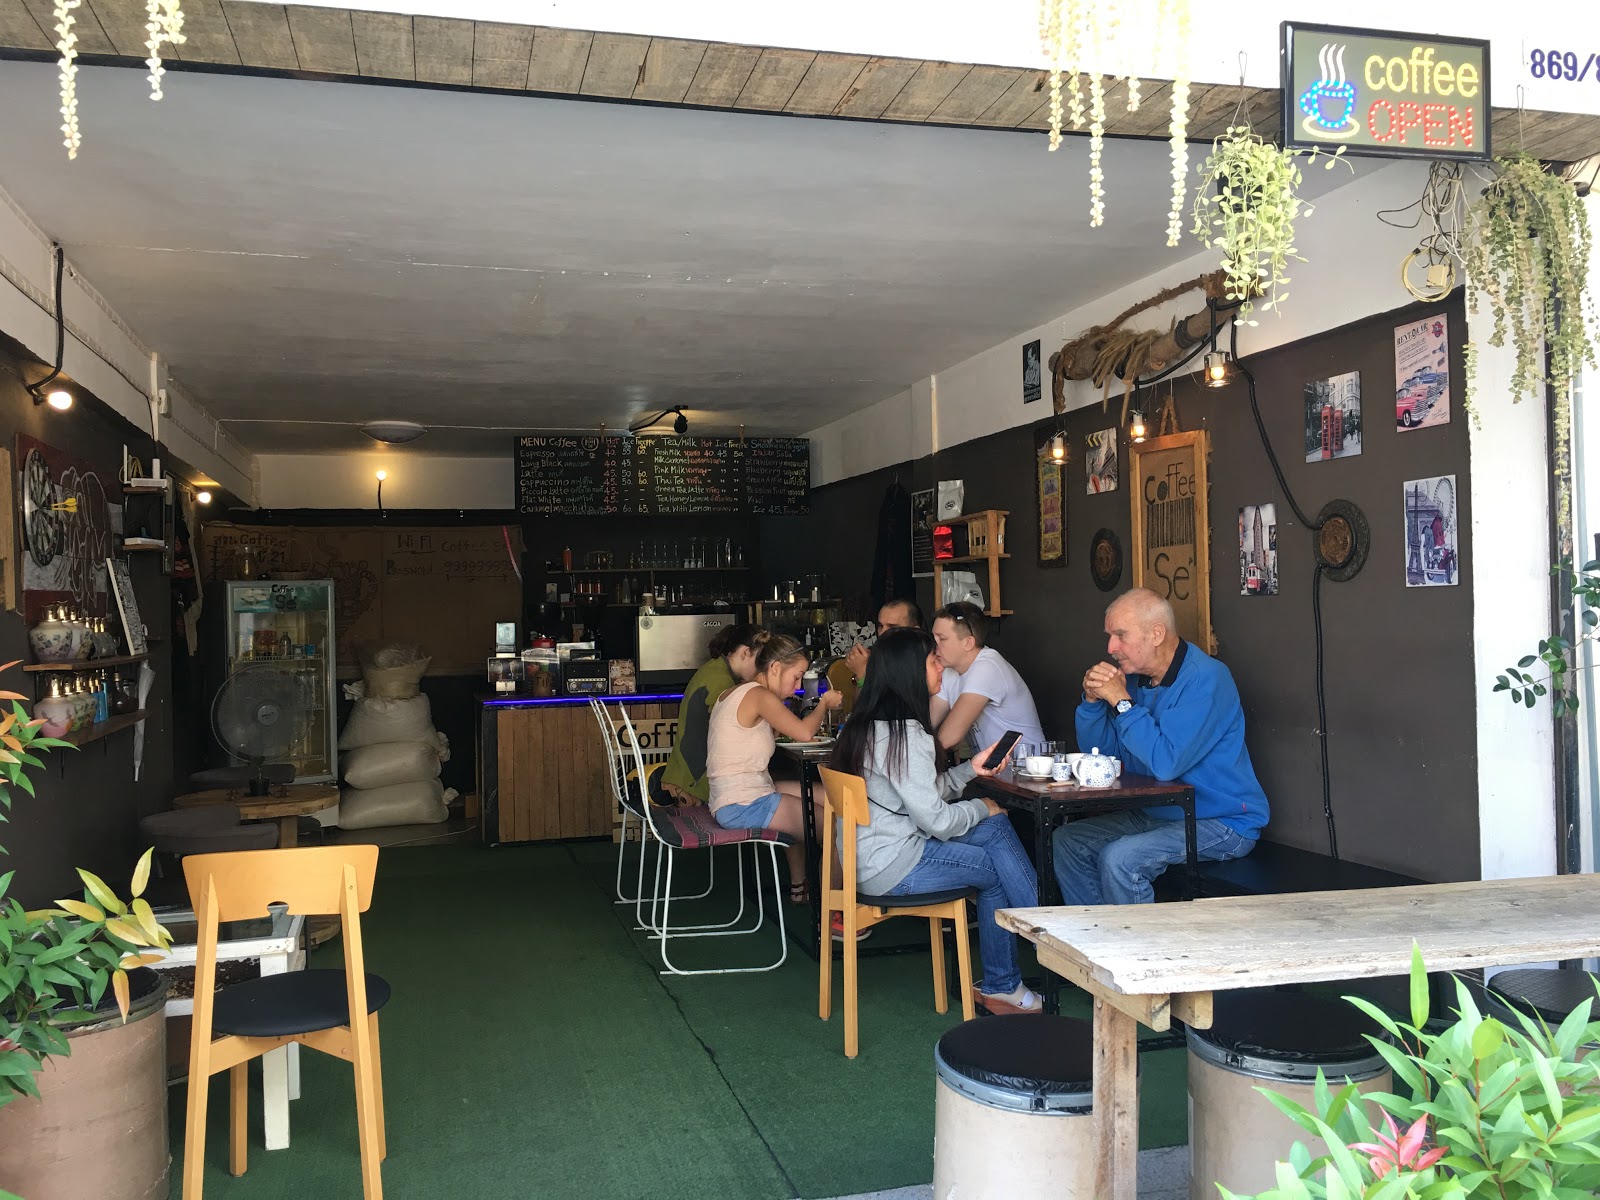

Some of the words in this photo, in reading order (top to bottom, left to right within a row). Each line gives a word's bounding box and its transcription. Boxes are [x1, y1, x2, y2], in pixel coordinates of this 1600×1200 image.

[1364, 46, 1479, 98] coffee
[1368, 99, 1475, 148] OPEN
[520, 437, 546, 447] MENU
[548, 437, 578, 448] Coffee
[660, 437, 698, 448] Tea/Milk
[520, 449, 556, 459] Espresso
[669, 448, 682, 457] Milk
[520, 460, 540, 471] Long
[541, 458, 563, 468] Black
[520, 469, 544, 478] Latte
[653, 465, 670, 474] Pink
[670, 465, 686, 474] Milk
[520, 479, 570, 488] Cappuccino
[655, 476, 673, 485] Thai
[673, 476, 685, 485] Tea
[521, 486, 548, 496] Piccolo
[537, 495, 562, 504] White
[655, 494, 670, 503] Tea
[657, 504, 672, 513] Tea
[441, 539, 490, 553] Coffee
